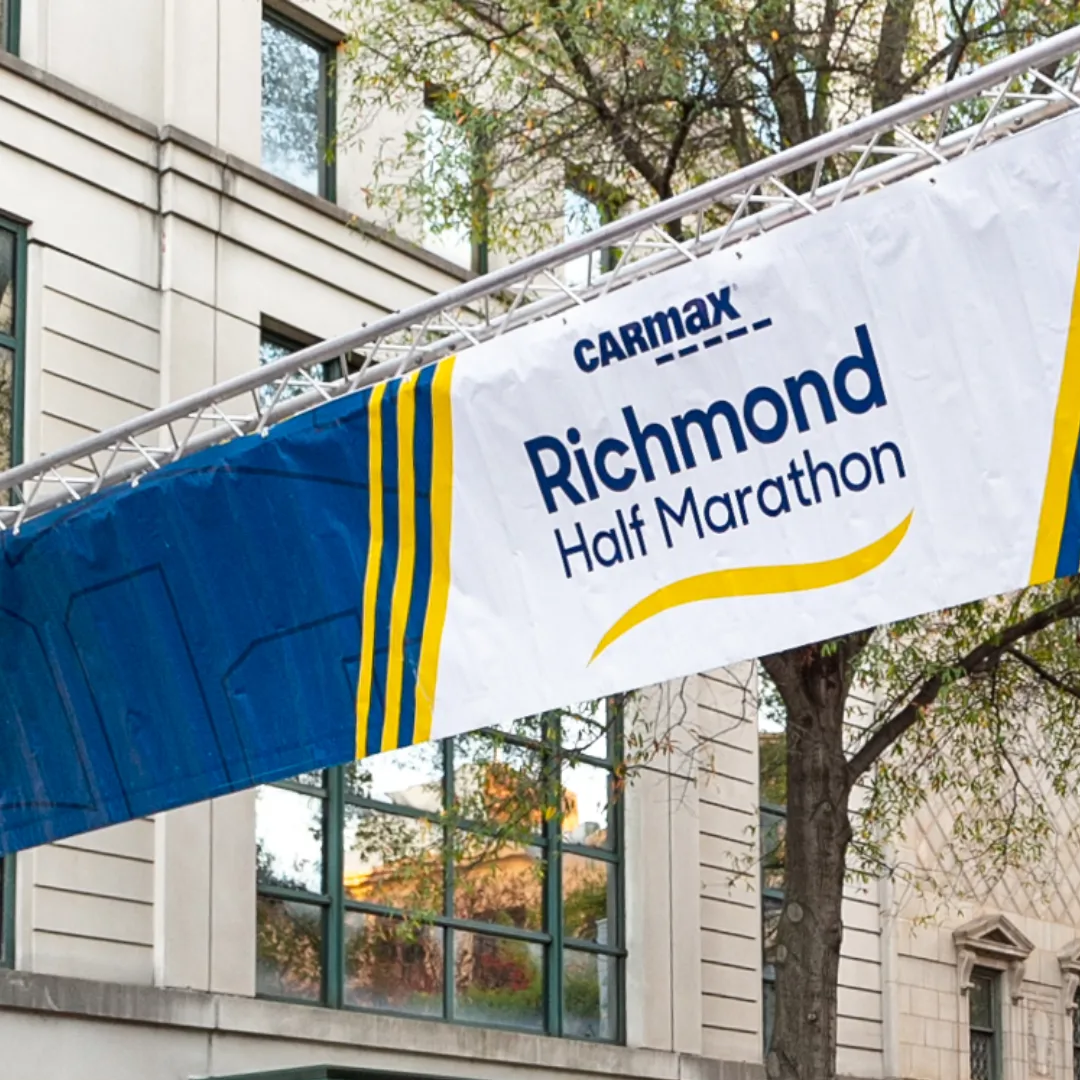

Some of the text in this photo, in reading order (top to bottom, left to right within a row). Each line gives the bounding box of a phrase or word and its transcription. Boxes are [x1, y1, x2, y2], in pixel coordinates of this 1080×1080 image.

[524, 324, 887, 514] Richmond
[554, 441, 906, 579] Half Marathon
